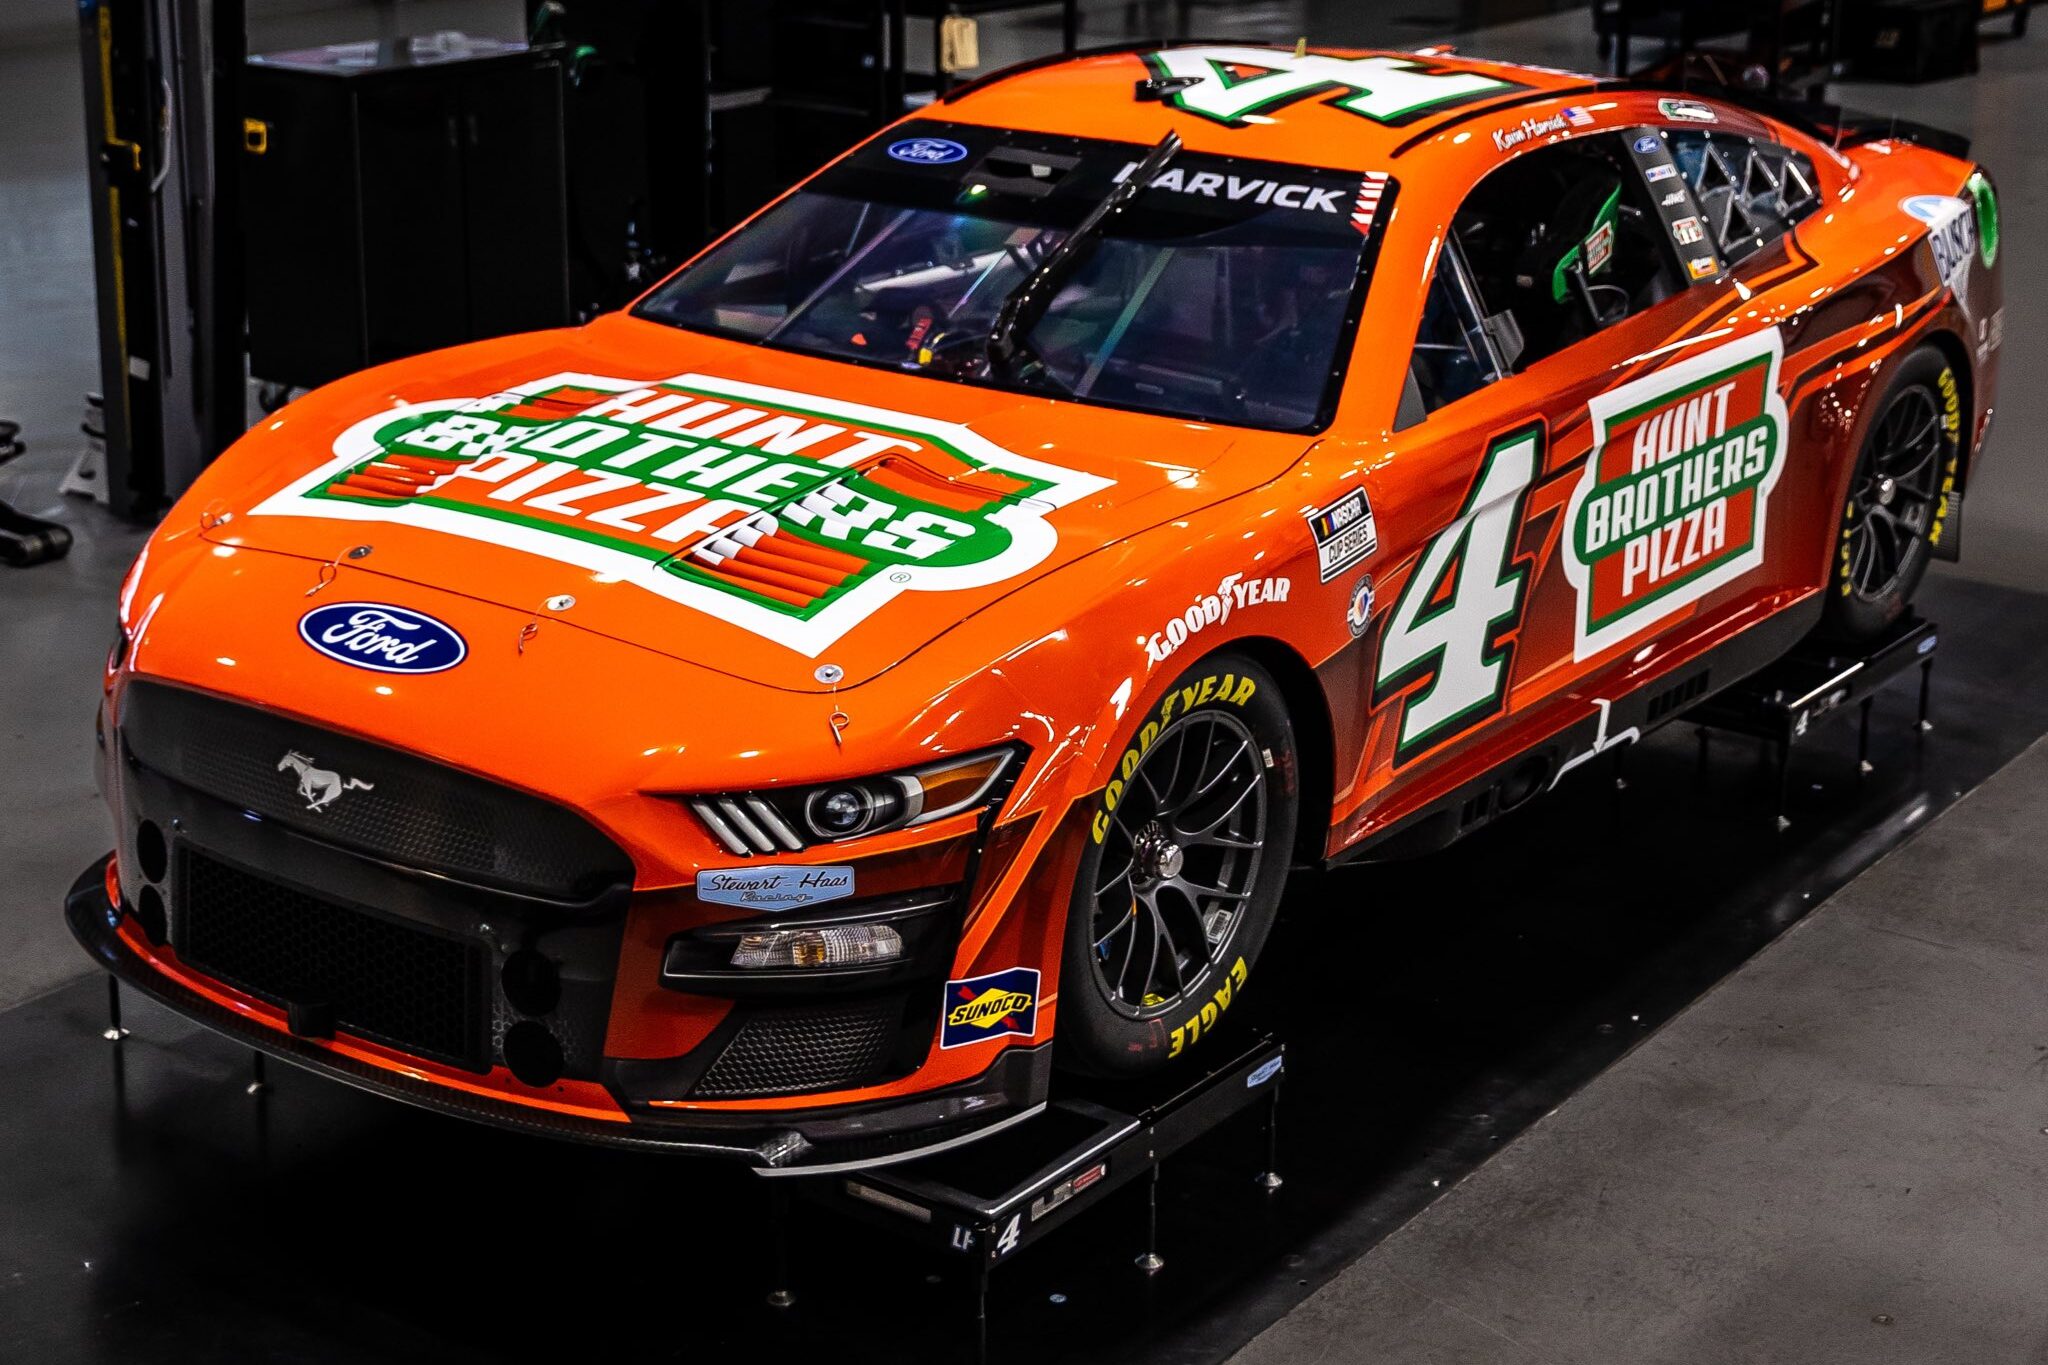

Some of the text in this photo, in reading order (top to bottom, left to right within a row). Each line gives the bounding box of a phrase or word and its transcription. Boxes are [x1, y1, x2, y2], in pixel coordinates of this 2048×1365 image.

[1153, 45, 1510, 122] 4
[899, 139, 954, 160] Ford
[576, 388, 924, 468] HUNT
[1631, 381, 1737, 475] HUNT
[394, 413, 977, 560] BROTHERS
[416, 449, 780, 567] PIZZA
[1330, 496, 1363, 530] NASCAR
[1585, 426, 1768, 554] BROTHERS
[1328, 524, 1368, 564] CUP SERIES
[1622, 496, 1729, 597] PIZZA
[1144, 572, 1291, 671] GOODYEAR
[1376, 430, 1538, 752] 4
[321, 610, 437, 664] Ford
[1092, 674, 1256, 844] GOODYEAR
[702, 874, 788, 891] Stewart
[800, 871, 849, 889] Haas
[739, 890, 813, 903] Racing
[951, 994, 1029, 1026] SUNOCO
[1168, 956, 1248, 1058] EAGLE
[997, 1212, 1021, 1255] 4
